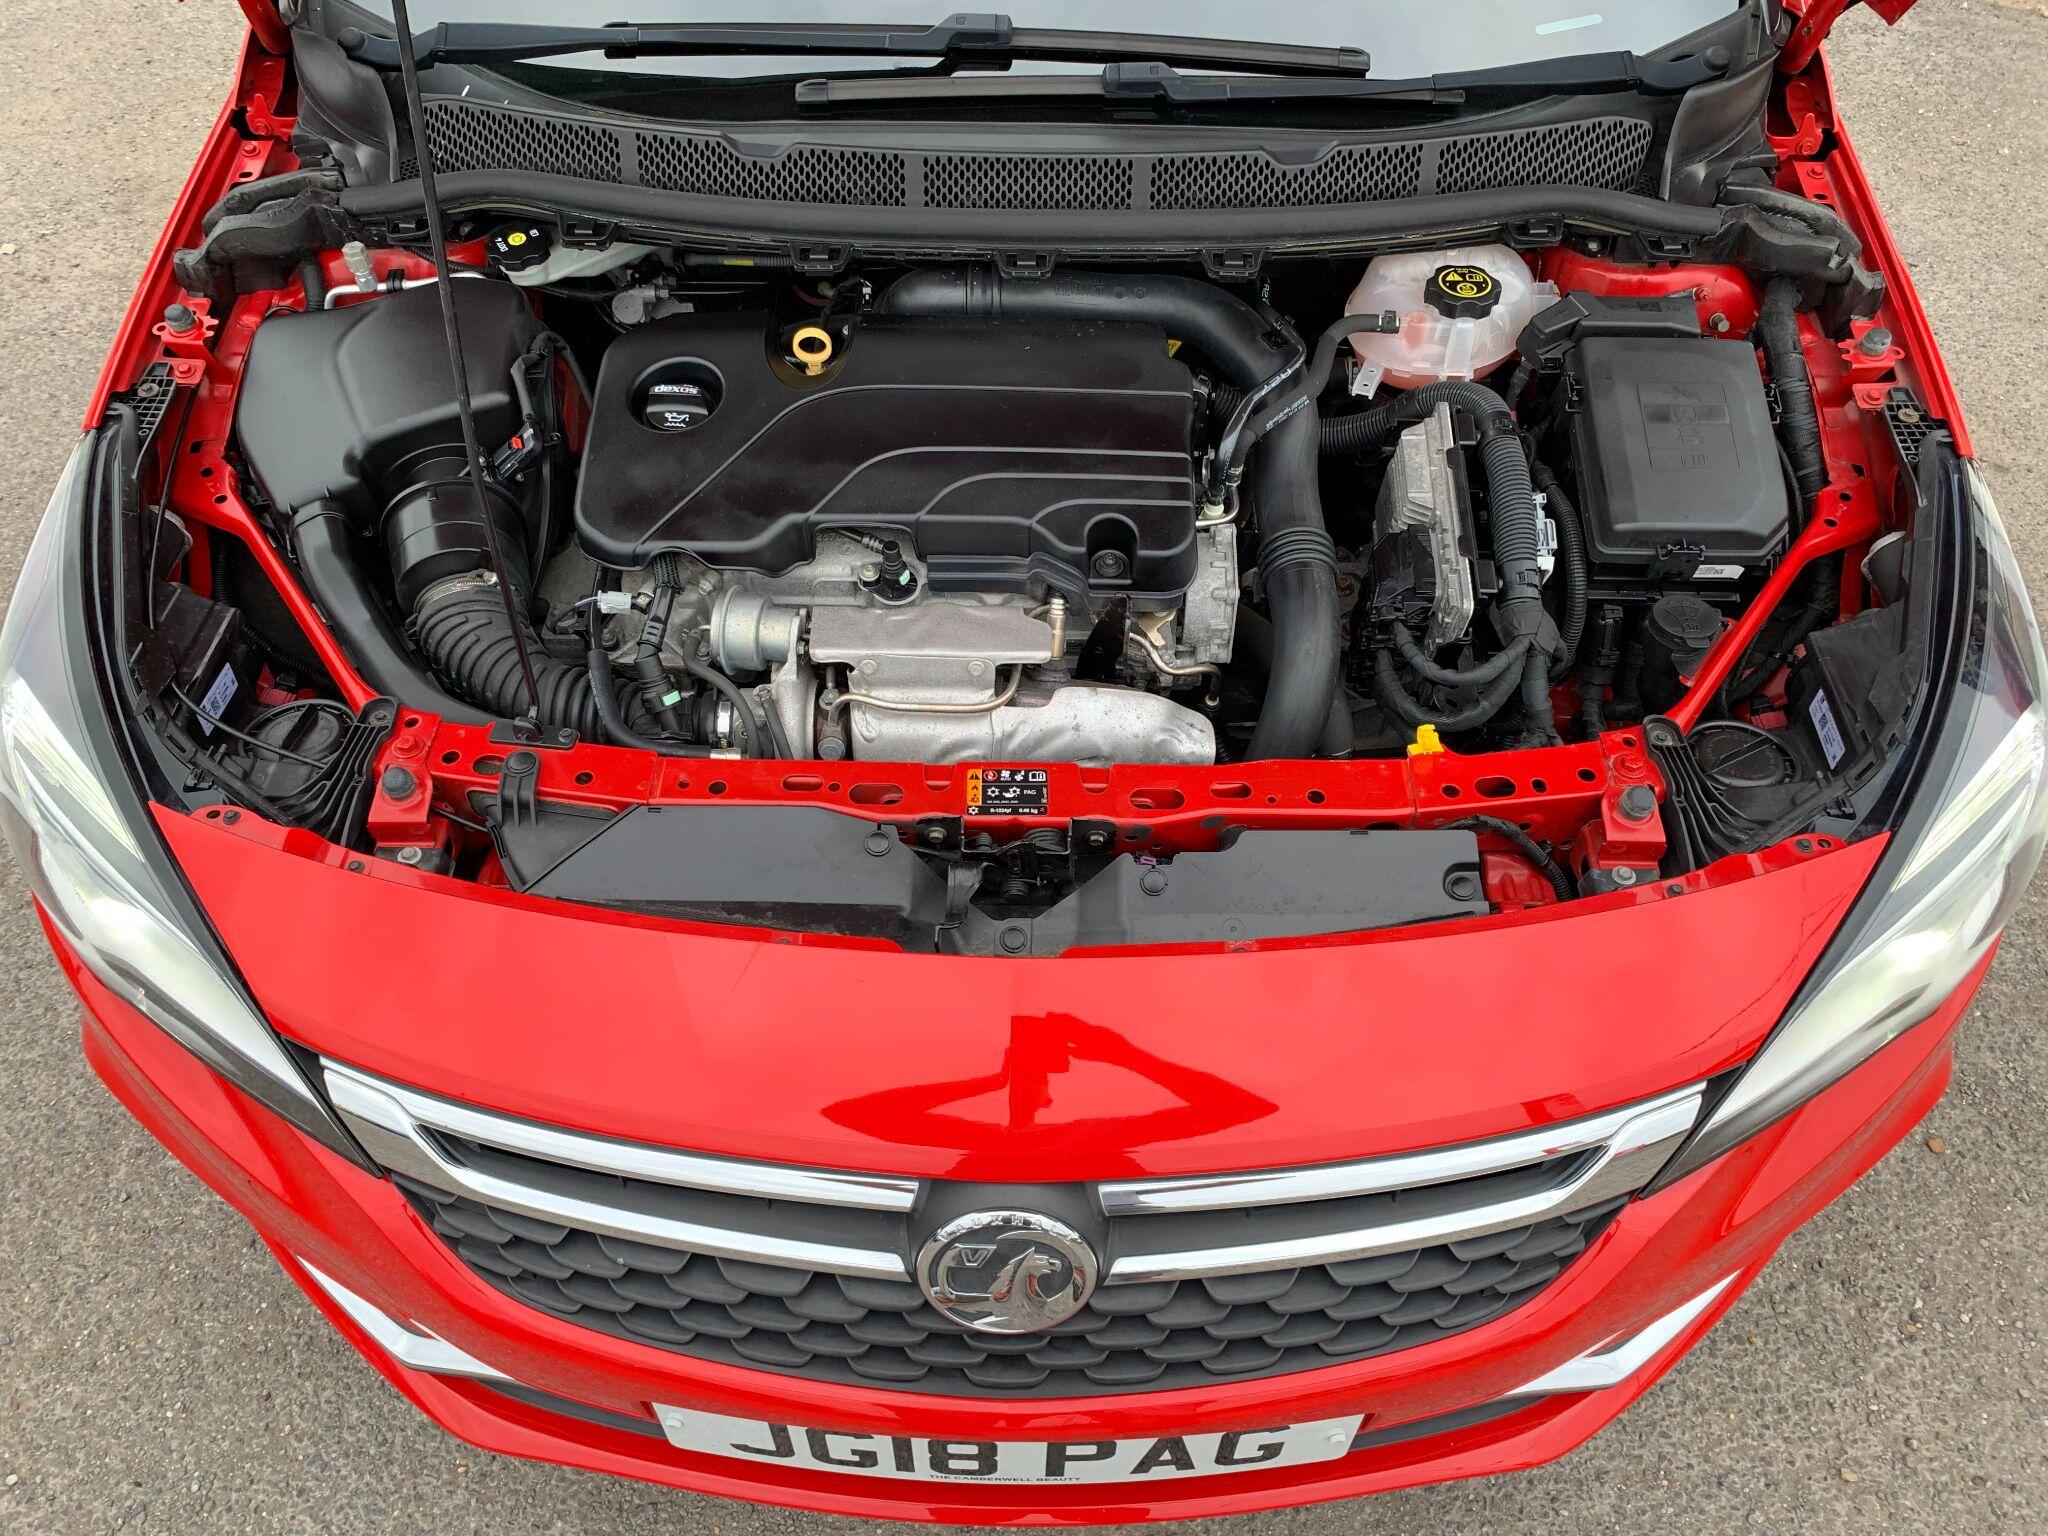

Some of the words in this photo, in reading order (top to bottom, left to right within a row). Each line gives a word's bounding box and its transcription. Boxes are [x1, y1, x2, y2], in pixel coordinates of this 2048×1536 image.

[655, 385, 698, 394] dexos
[730, 1422, 998, 1477] JG18
[1045, 1425, 1291, 1477] PAG
